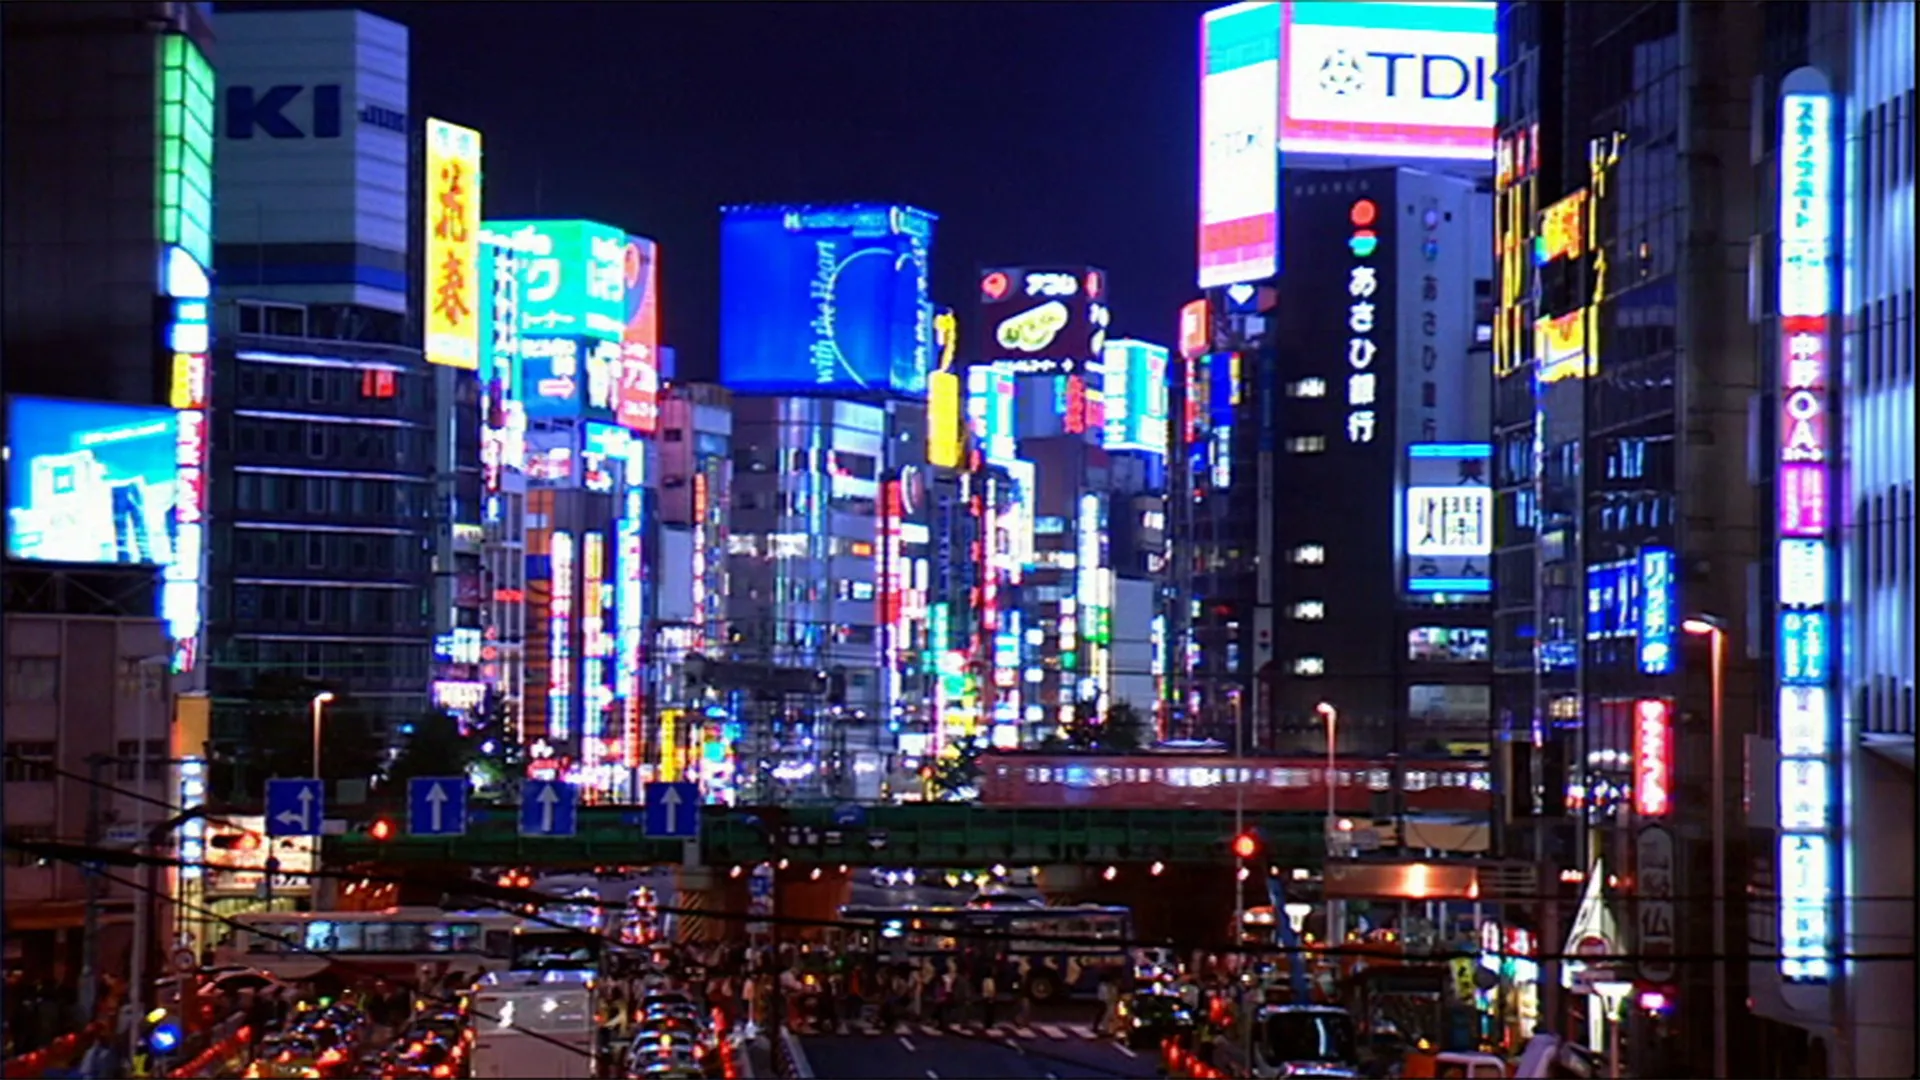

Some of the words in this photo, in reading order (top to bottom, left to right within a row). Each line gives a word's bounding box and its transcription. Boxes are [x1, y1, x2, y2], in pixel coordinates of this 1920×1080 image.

[810, 340, 835, 383] with
[1347, 265, 1377, 442] あさひ銀行
